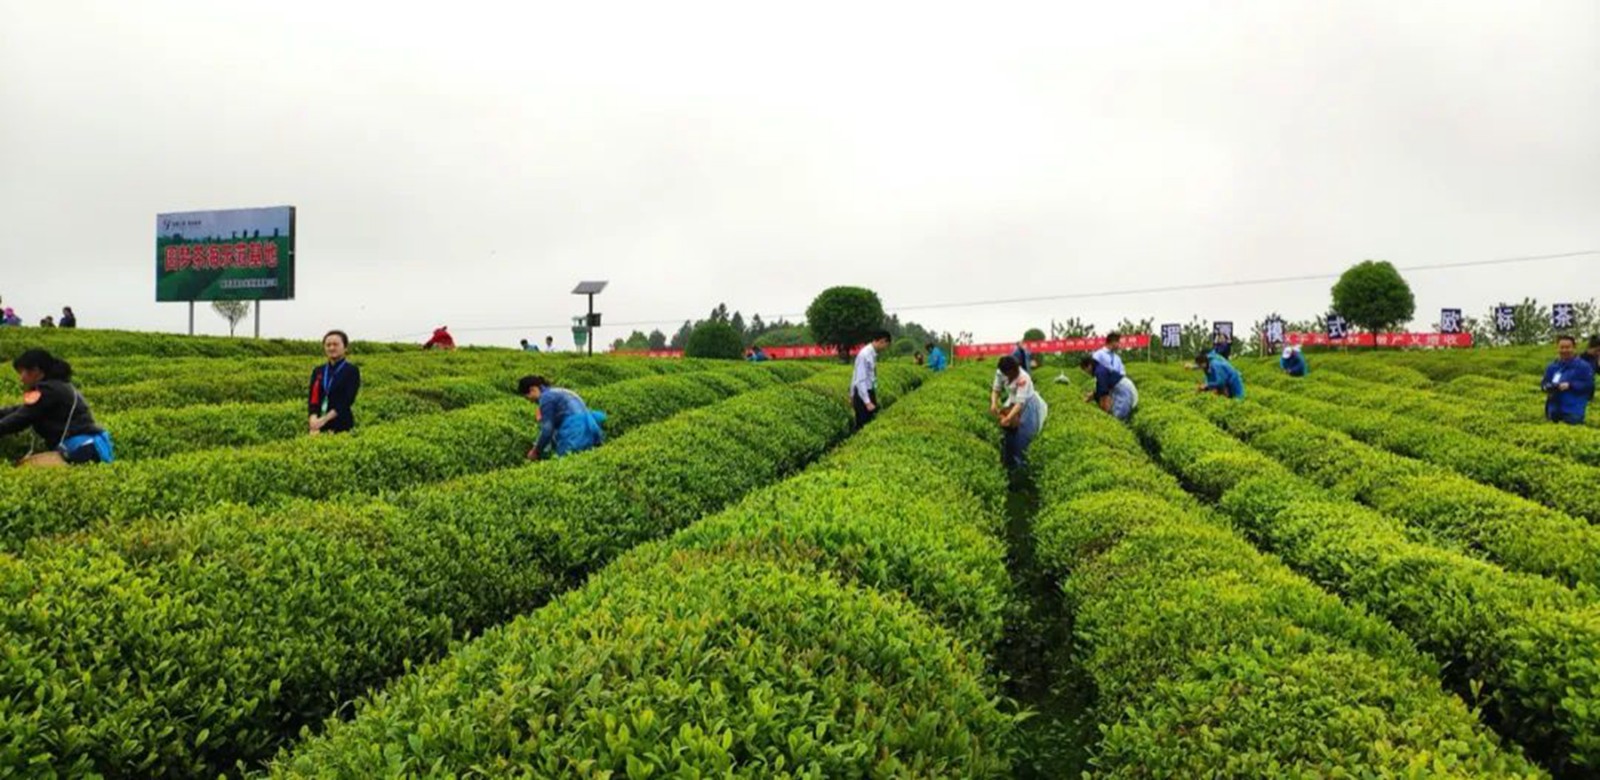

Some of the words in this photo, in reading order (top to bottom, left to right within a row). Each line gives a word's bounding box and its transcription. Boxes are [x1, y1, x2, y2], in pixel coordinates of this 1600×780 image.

[1267, 319, 1284, 342] 模
[1328, 315, 1346, 337] 式
[1440, 310, 1460, 332] 欧
[1496, 309, 1515, 330] 标
[1554, 304, 1573, 327] 茶
